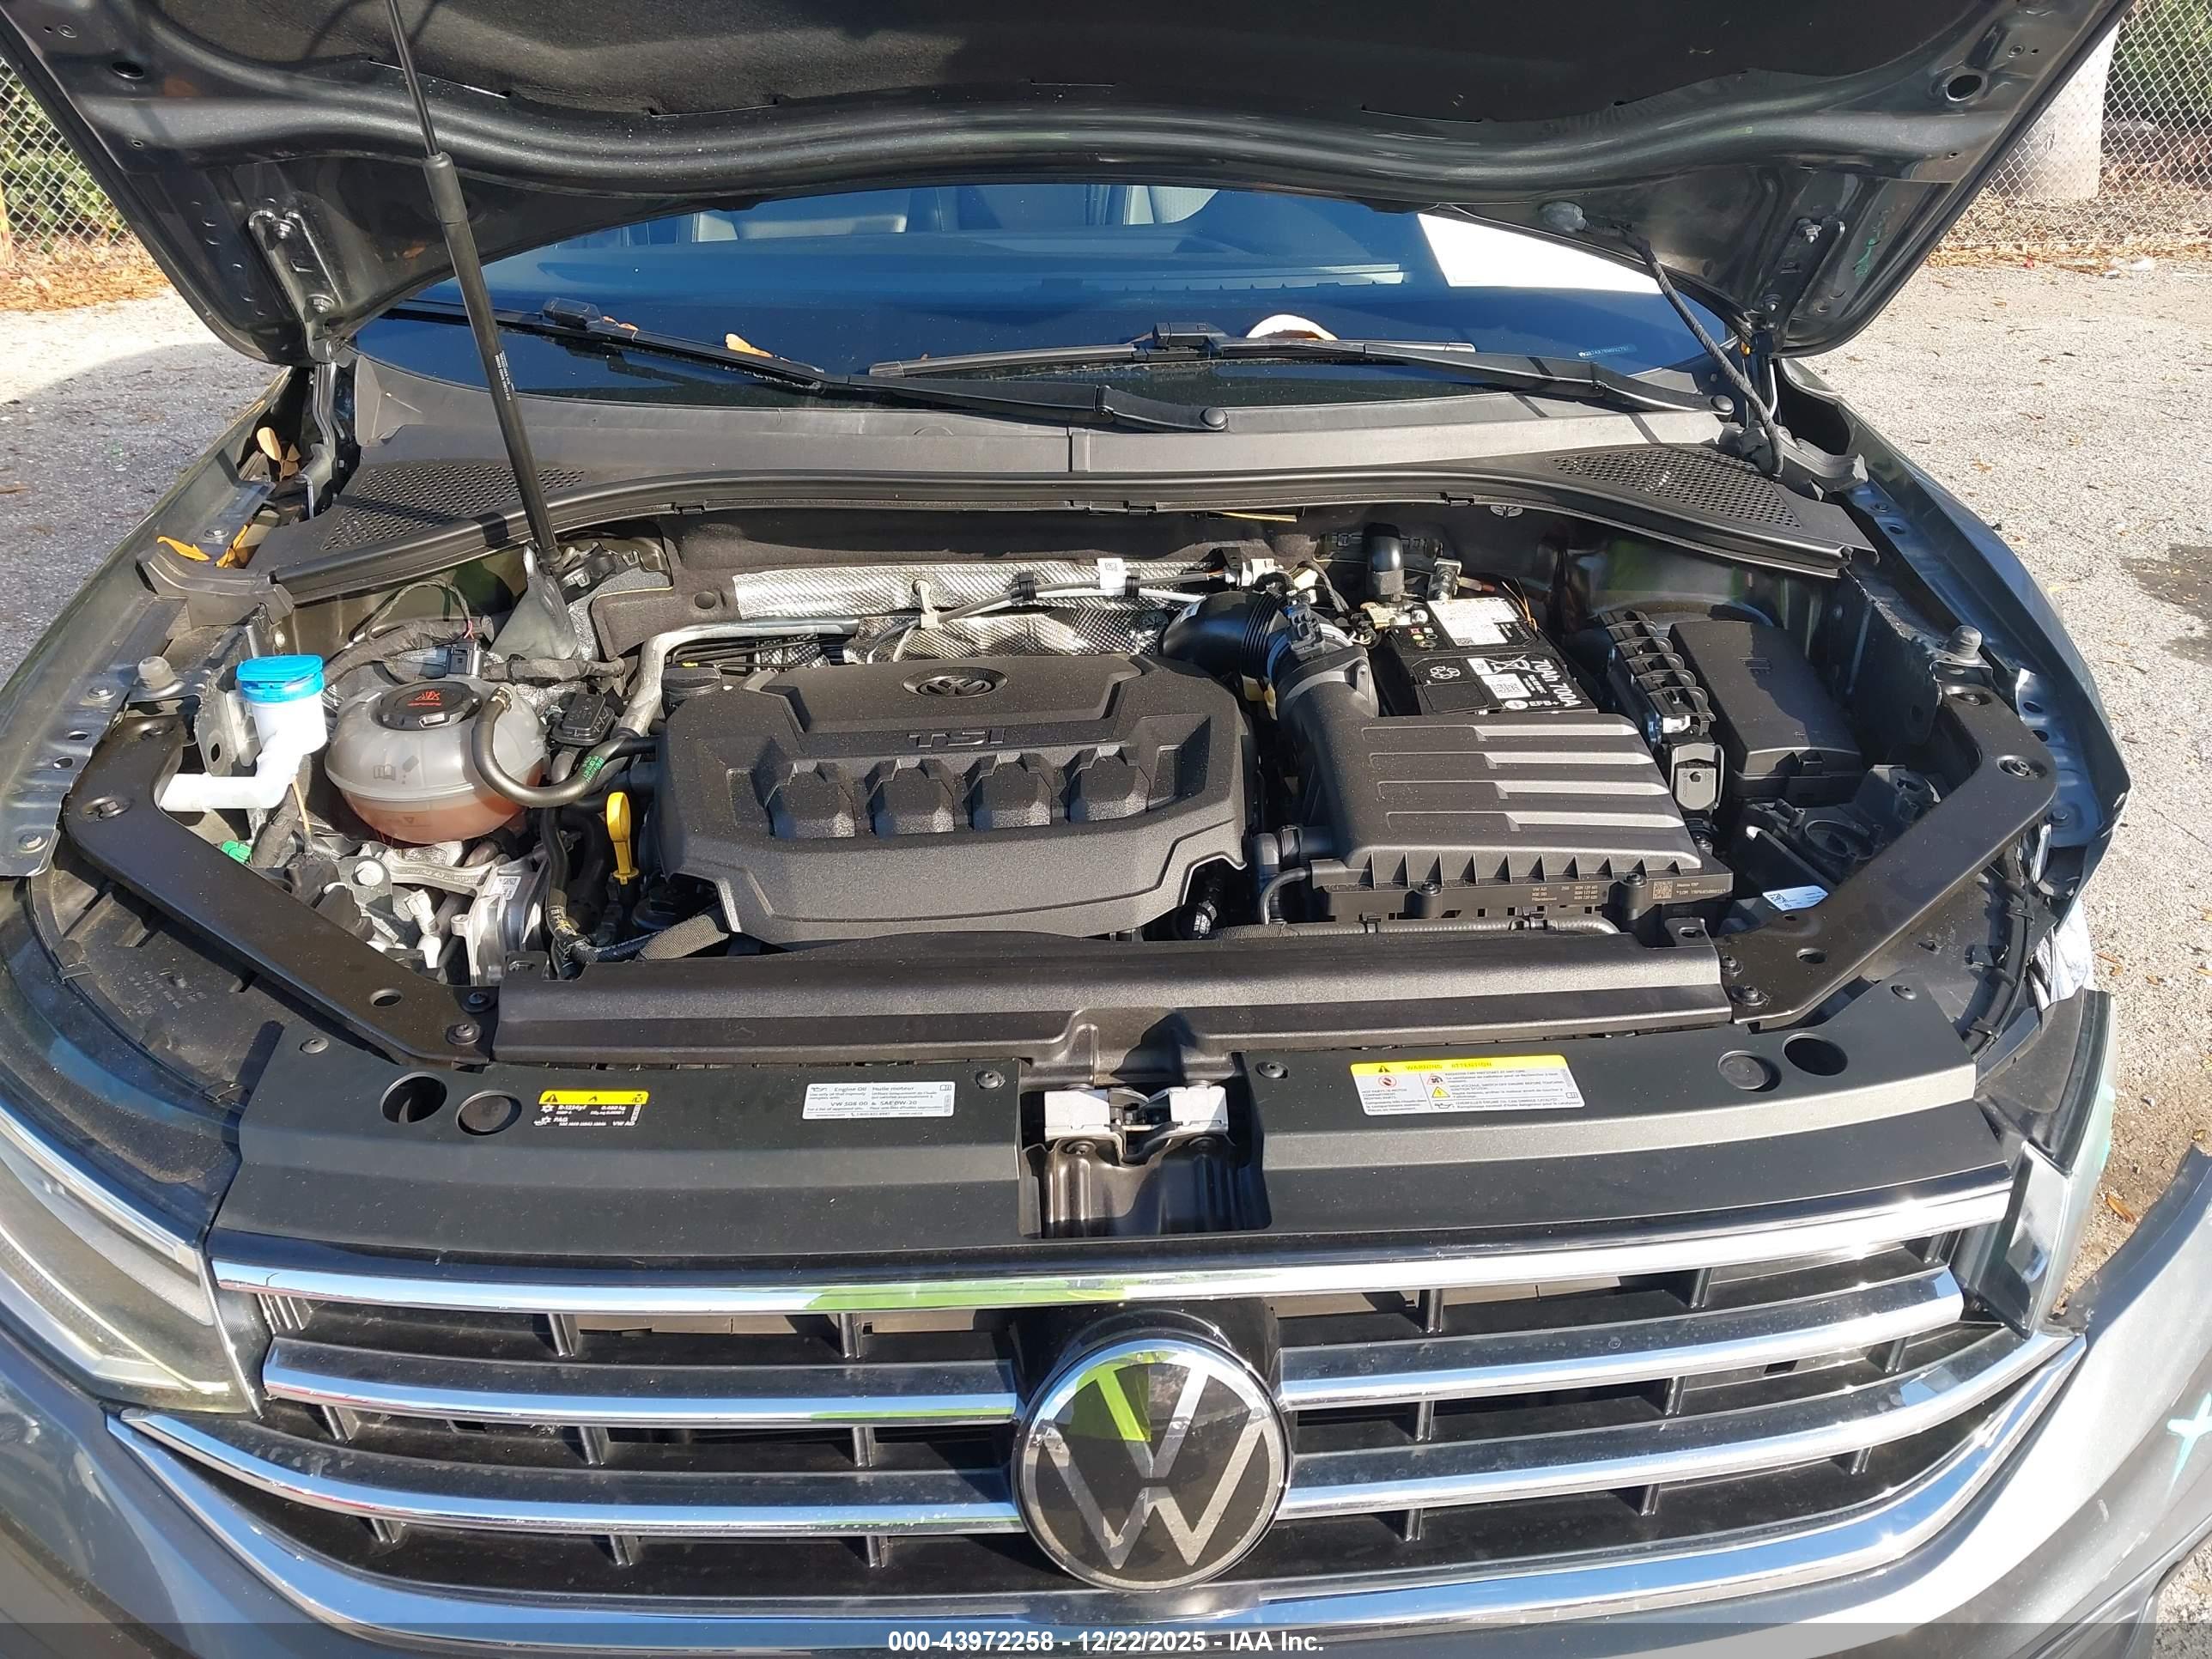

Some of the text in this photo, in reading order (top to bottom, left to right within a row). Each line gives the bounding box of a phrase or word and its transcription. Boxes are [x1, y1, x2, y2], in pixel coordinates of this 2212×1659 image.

[1530, 659, 1561, 682] 70Ah
[1549, 683, 1582, 707] 700A
[907, 728, 1006, 748] TSI
[1035, 1352, 1271, 1571] VW
